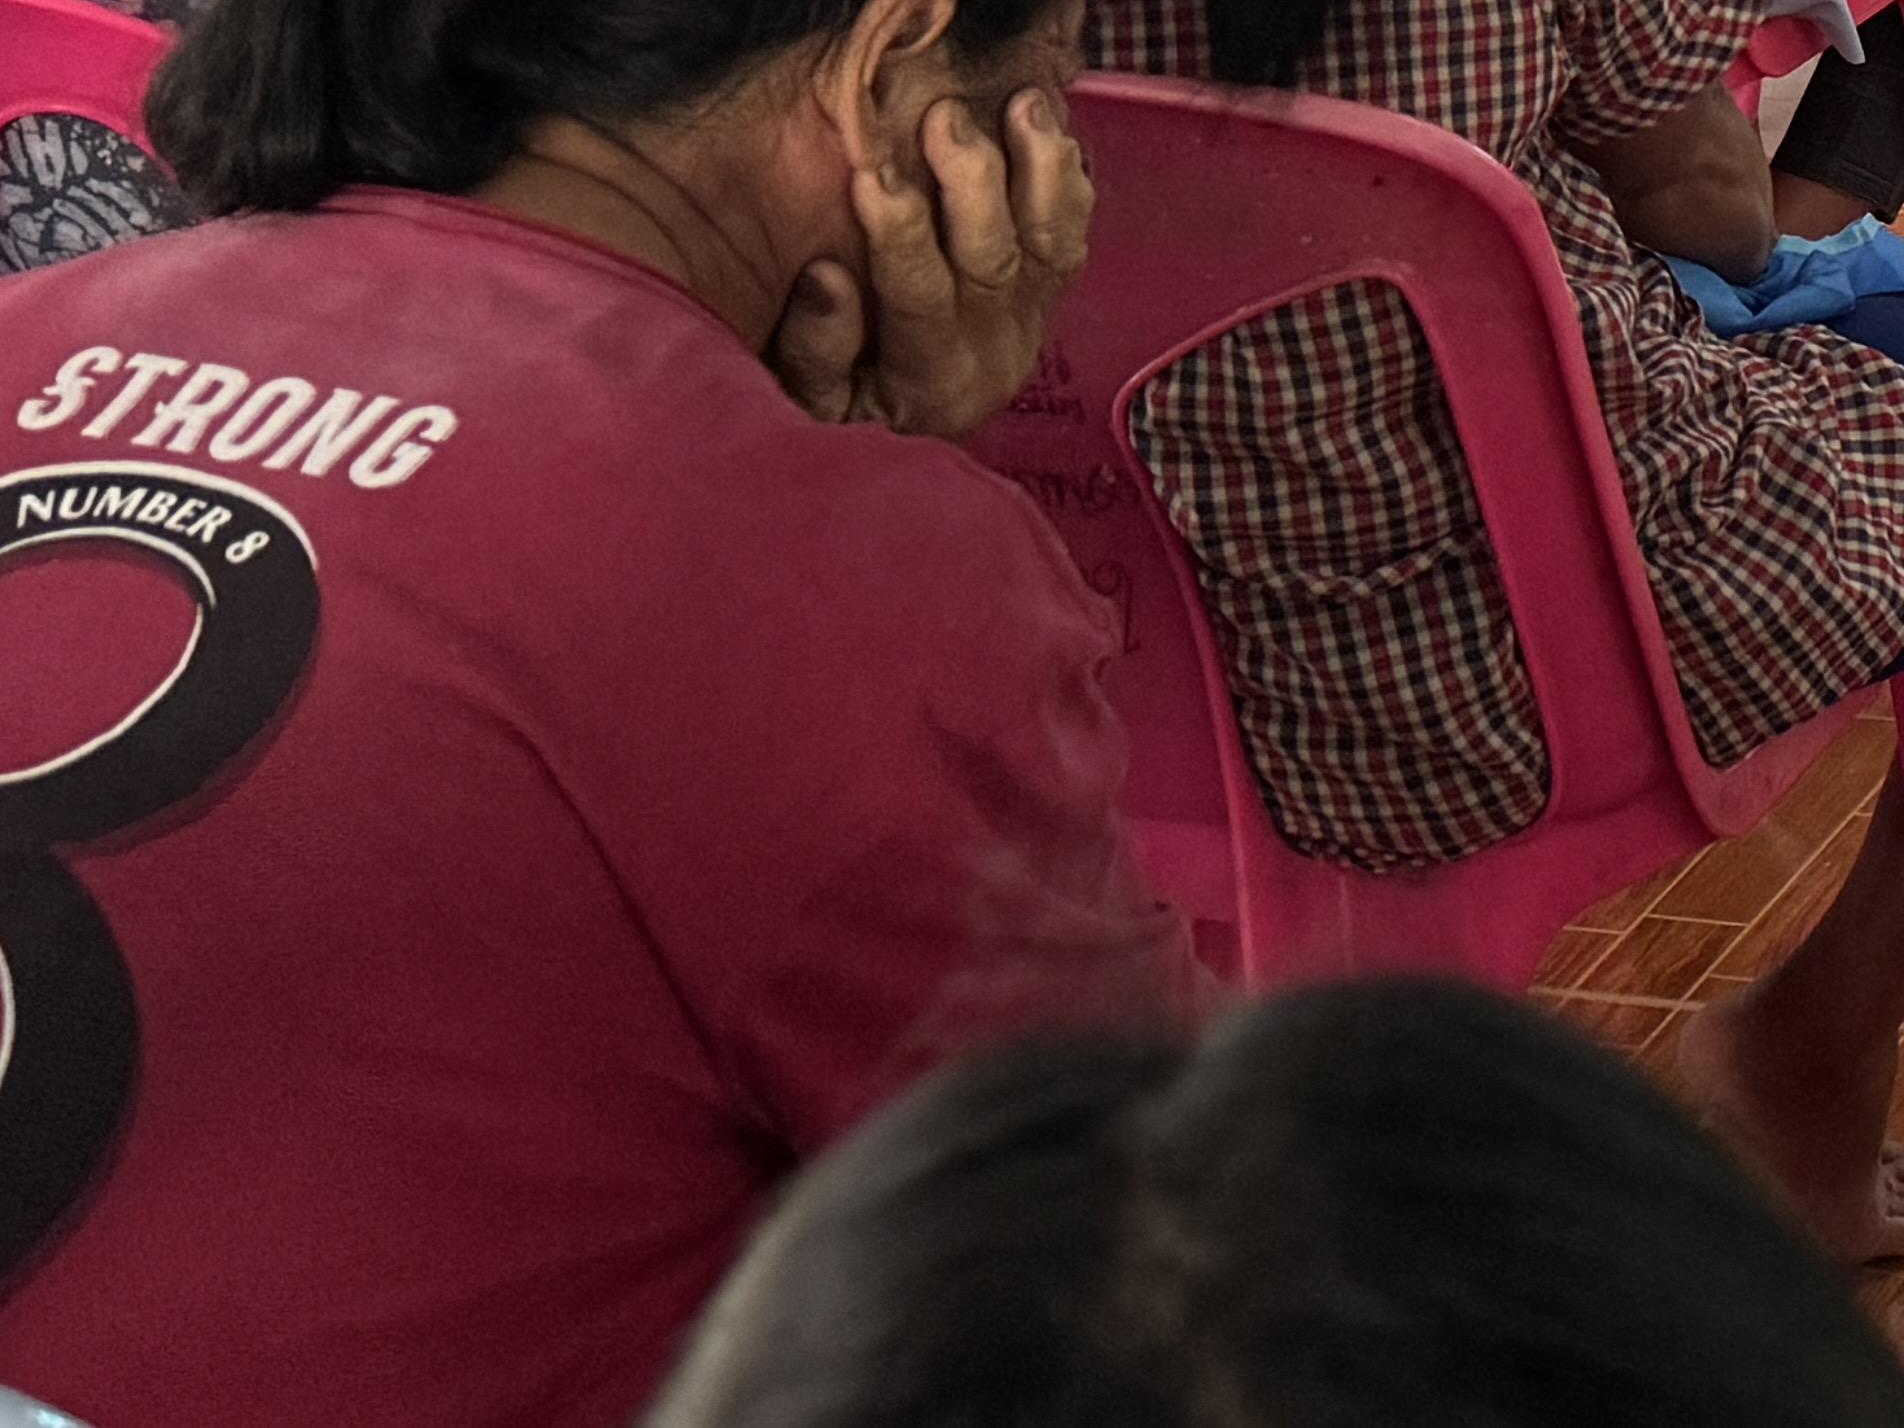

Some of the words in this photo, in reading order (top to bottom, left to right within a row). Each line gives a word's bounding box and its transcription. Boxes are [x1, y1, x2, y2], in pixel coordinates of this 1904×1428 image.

[17, 345, 457, 489] STRONG
[16, 484, 233, 543] NUMBER
[224, 530, 270, 564] 8
